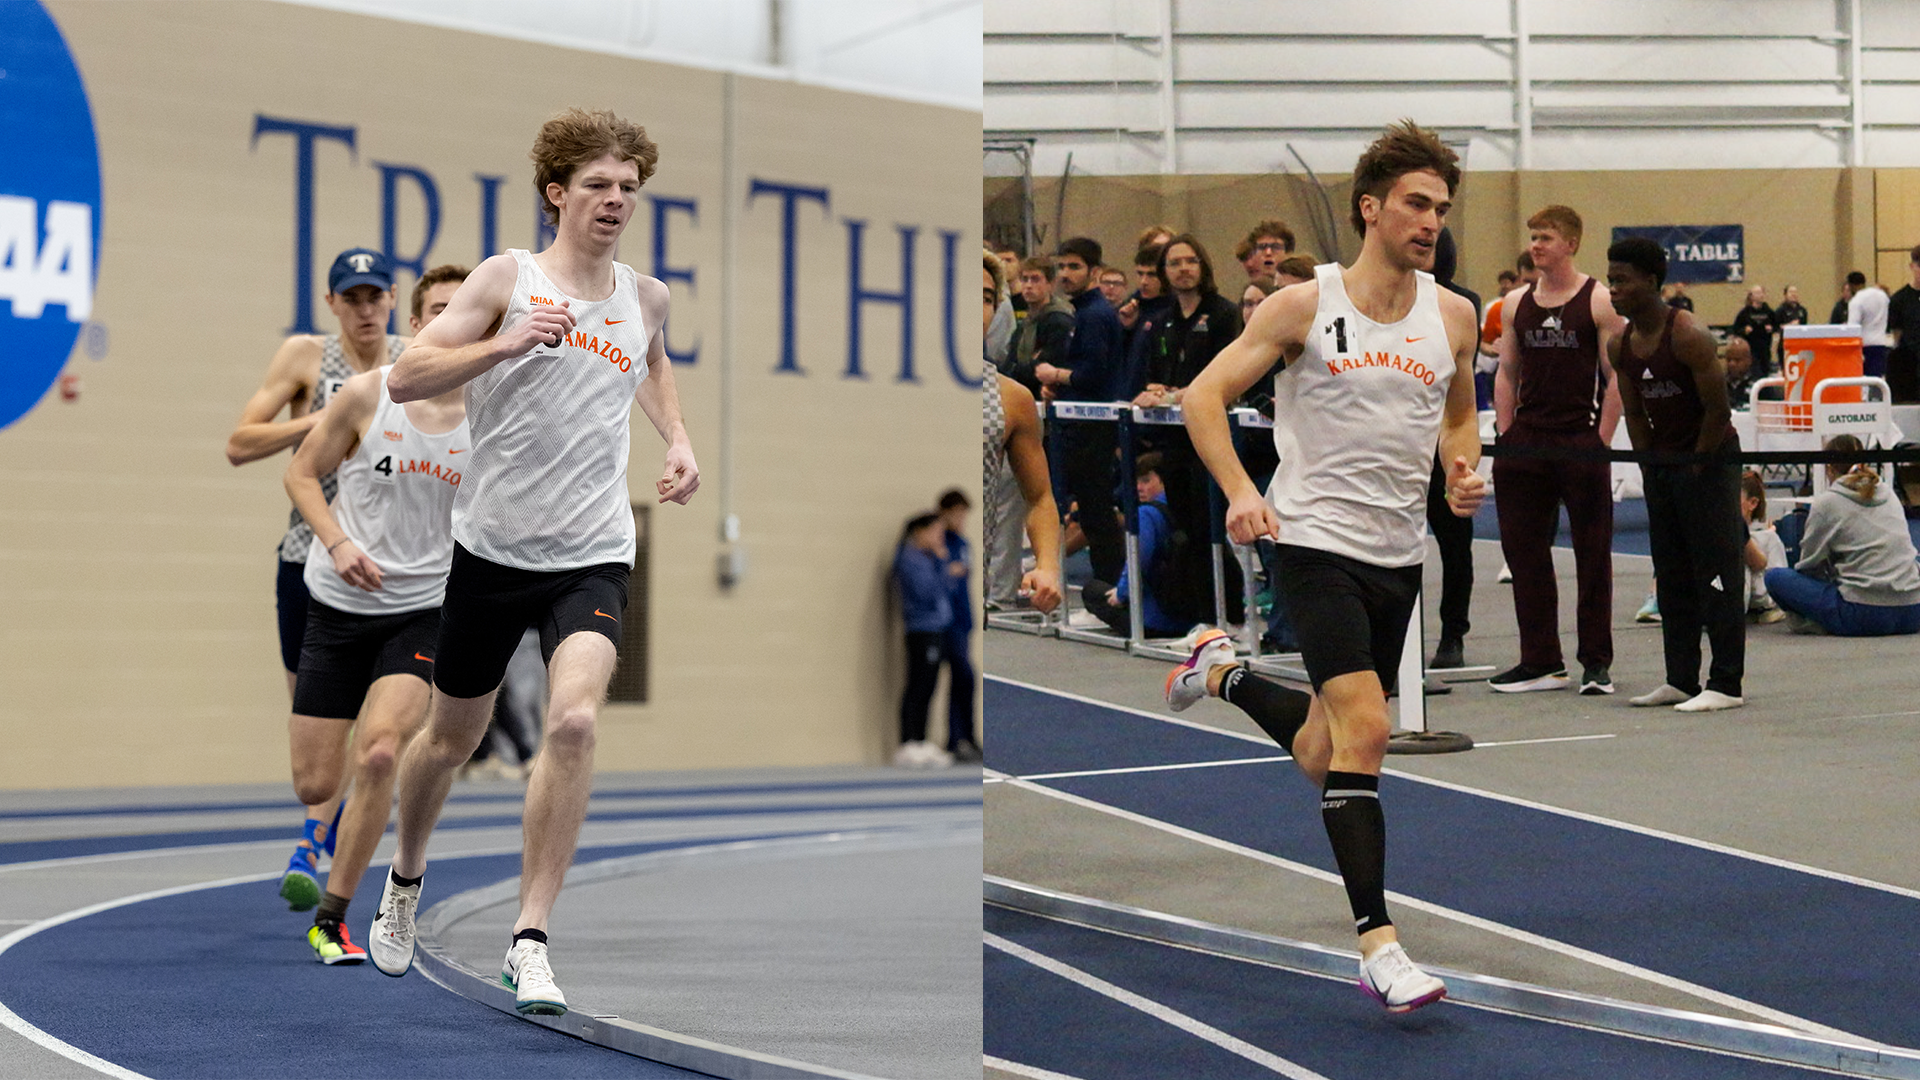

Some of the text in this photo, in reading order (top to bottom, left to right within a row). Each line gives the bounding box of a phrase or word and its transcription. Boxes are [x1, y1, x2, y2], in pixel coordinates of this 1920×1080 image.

[250, 112, 702, 368] TRIE
[1675, 243, 1740, 261] TABLE
[349, 253, 374, 273] T
[529, 295, 555, 306] MIAA
[1524, 330, 1580, 348] ALMA
[565, 331, 632, 373] AMAZOO
[1326, 351, 1436, 386] KALAMAZOO
[1828, 413, 1877, 424] GATORADE
[374, 455, 393, 477] 4
[398, 459, 462, 489] LAMAZO
